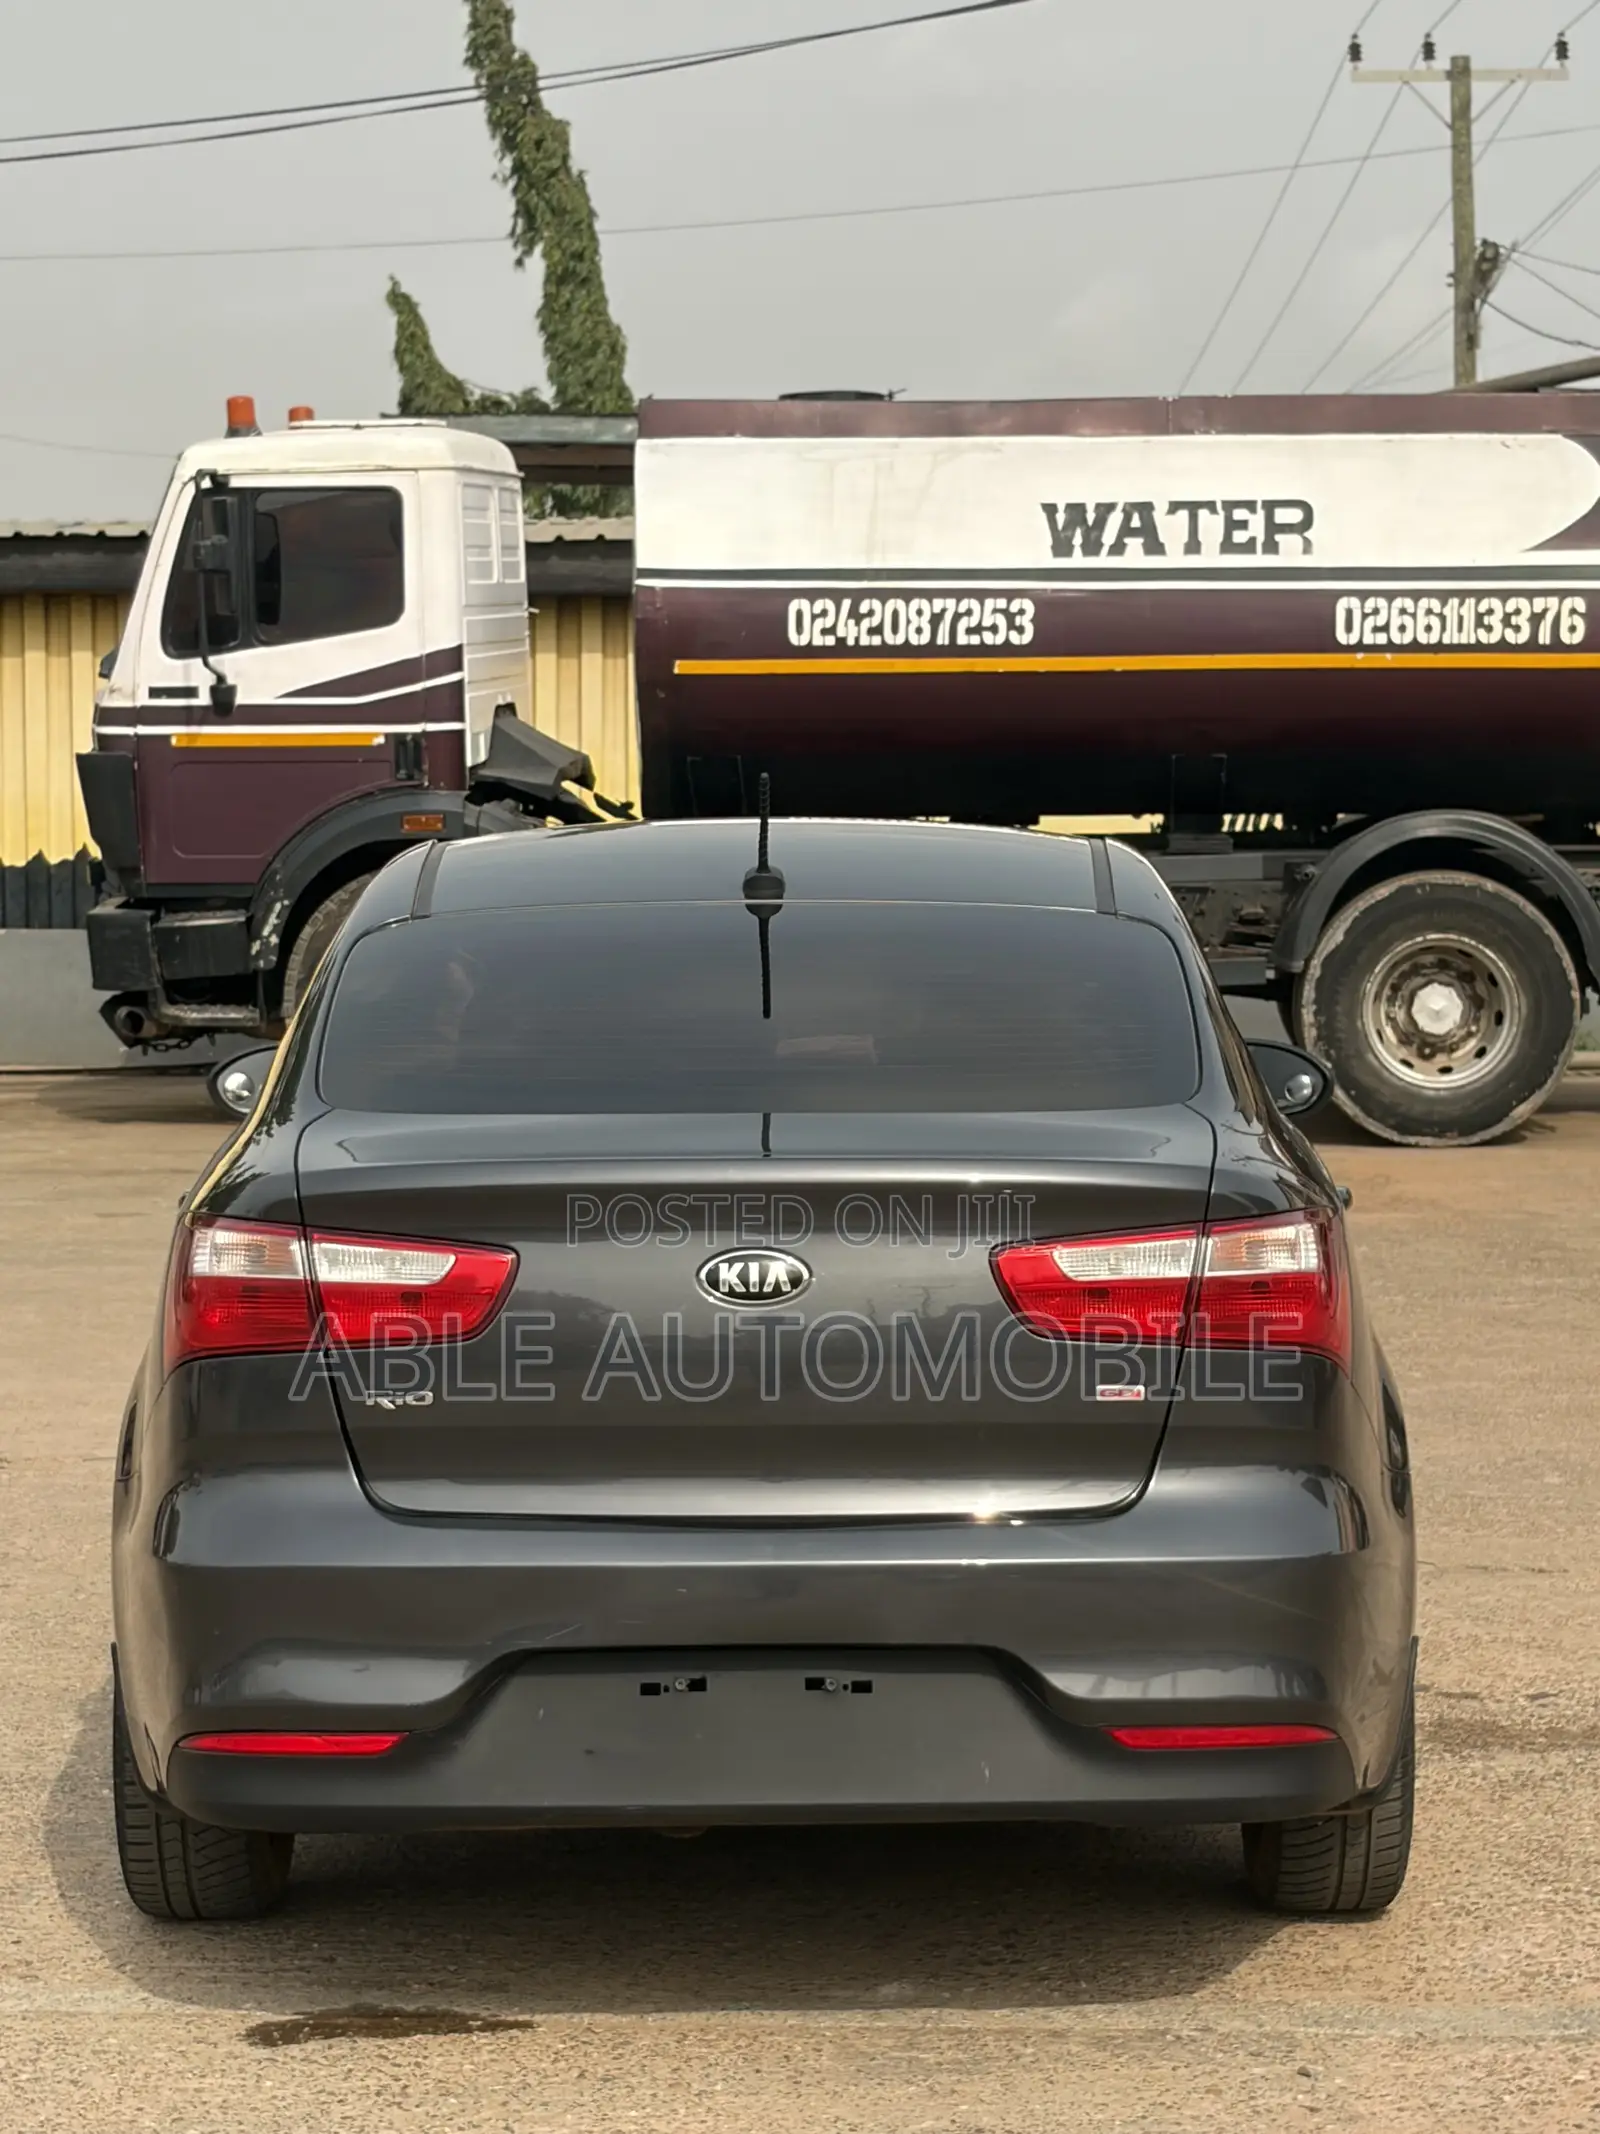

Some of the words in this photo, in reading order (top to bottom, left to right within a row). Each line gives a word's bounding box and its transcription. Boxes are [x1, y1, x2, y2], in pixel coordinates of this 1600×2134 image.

[1040, 500, 1315, 557] WATER
[787, 598, 1035, 646] 0242087253
[1335, 597, 1587, 645] 0266113376
[718, 1261, 792, 1293] KIA
